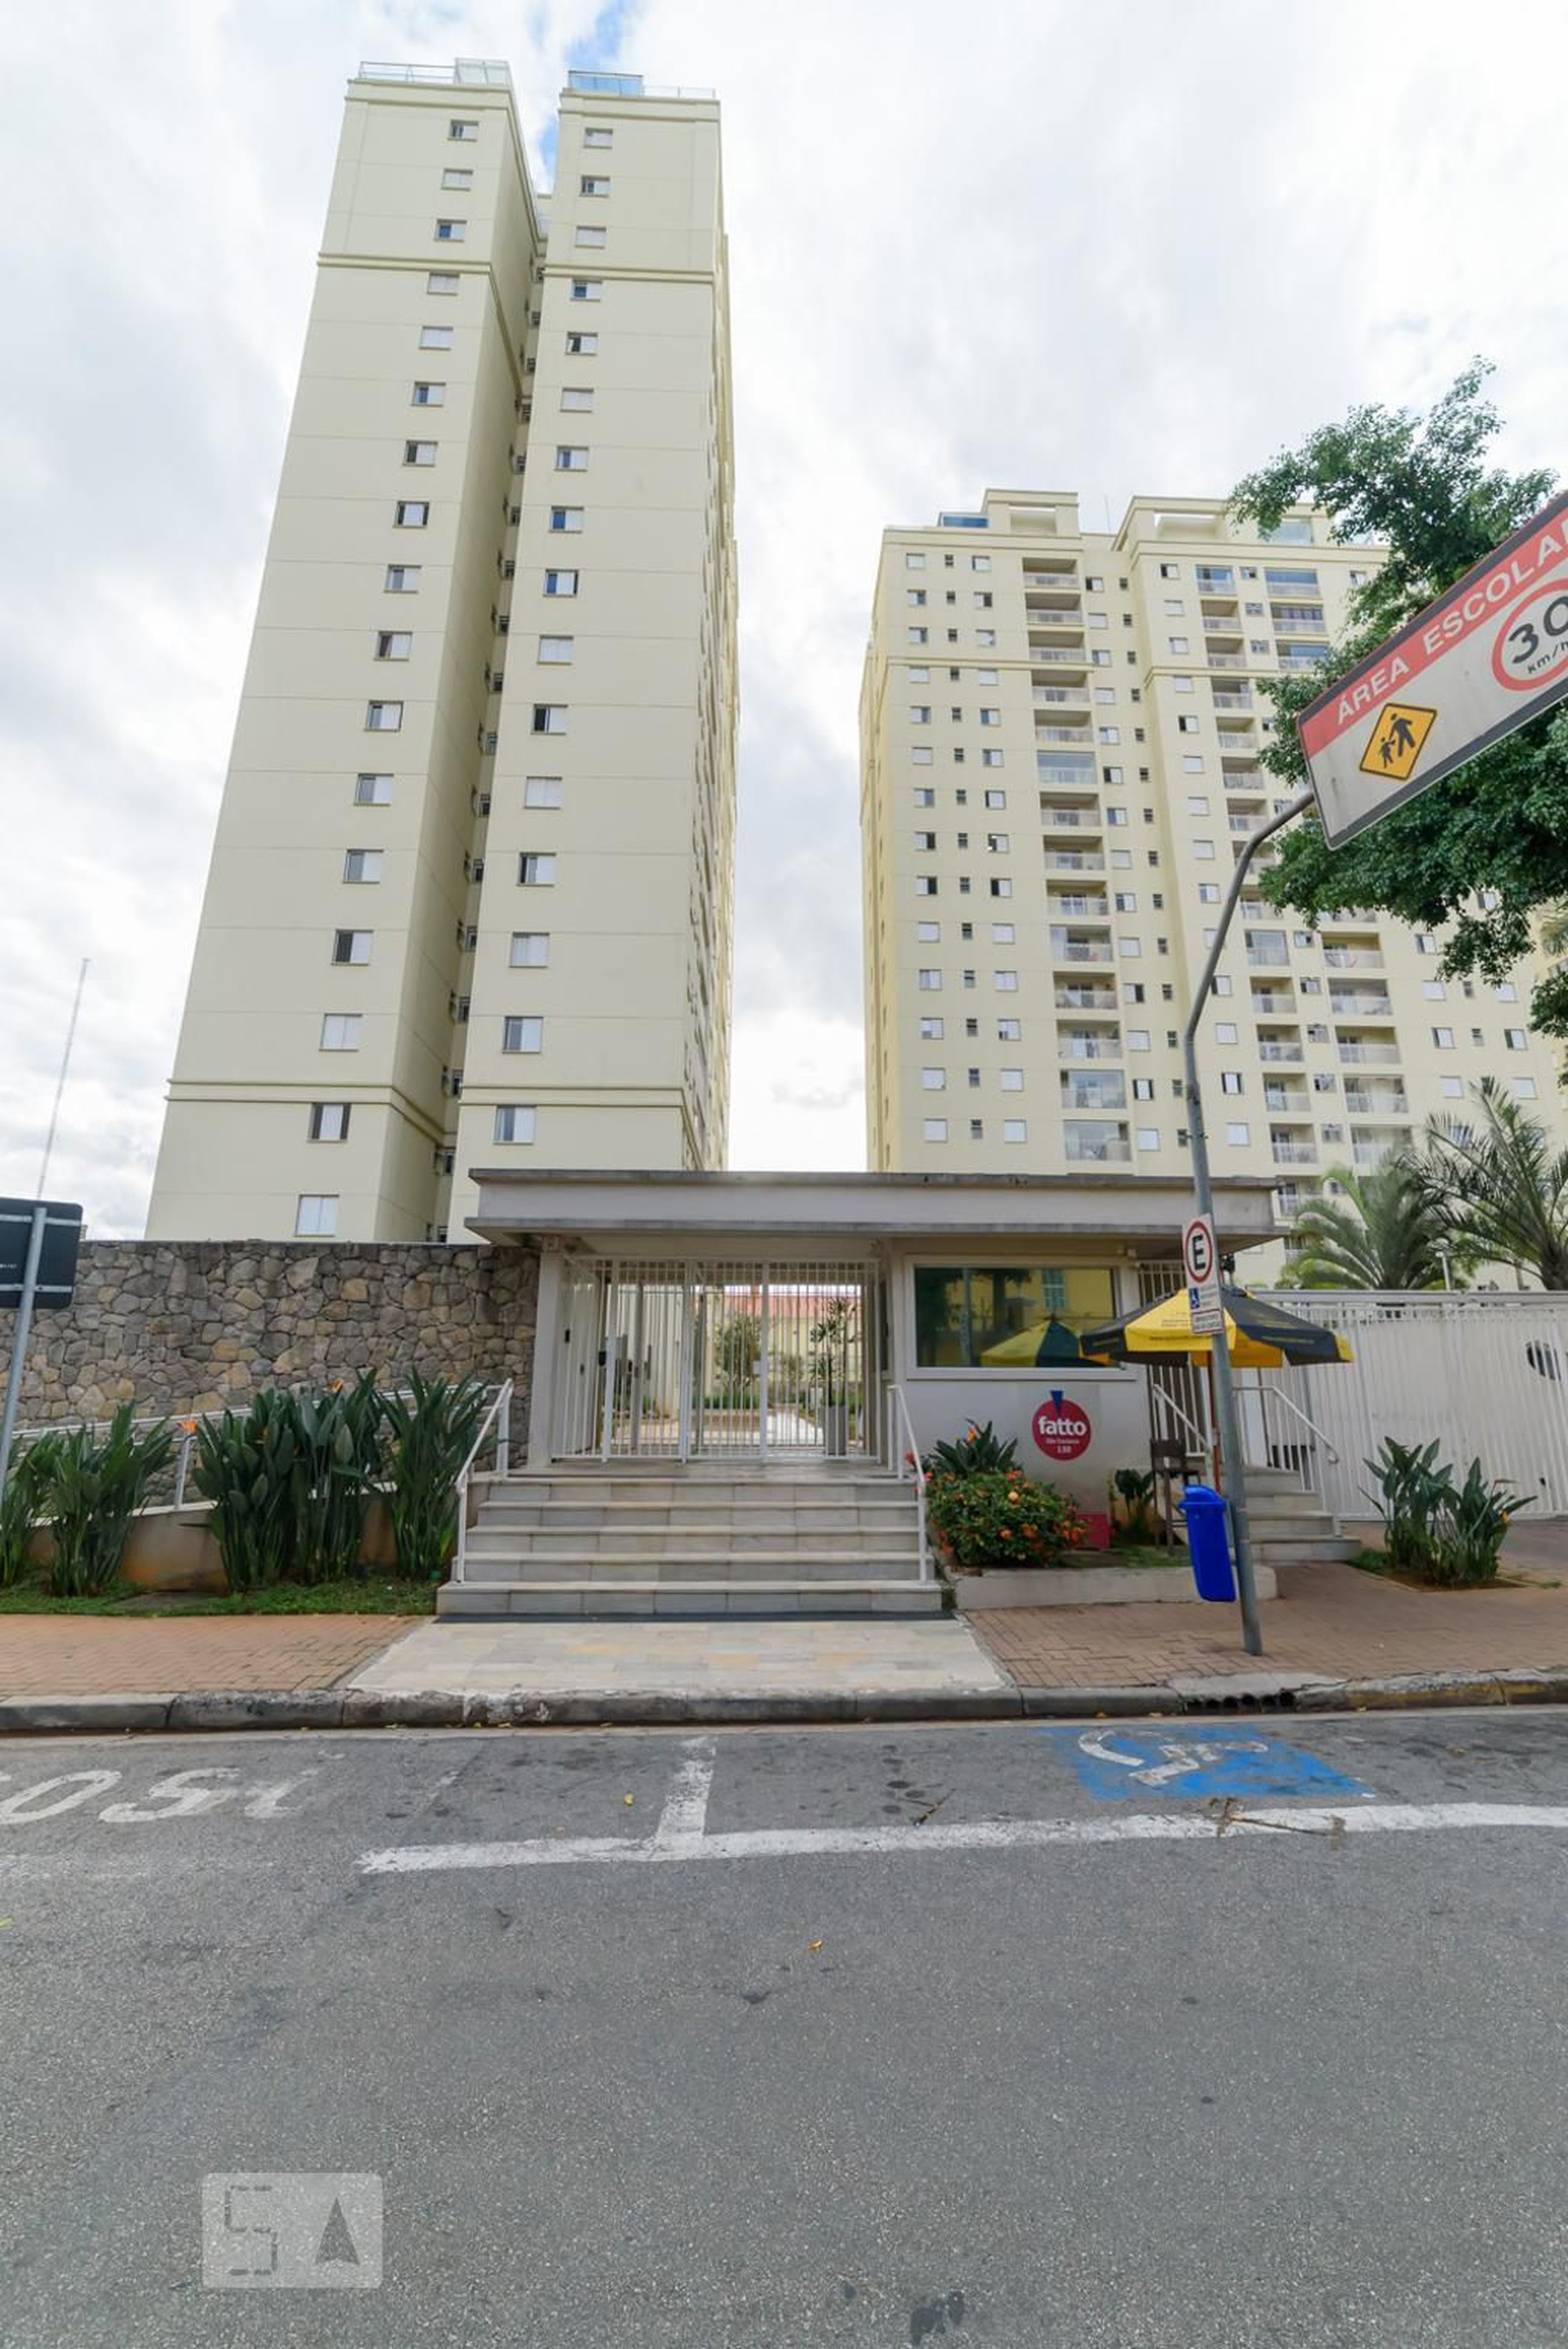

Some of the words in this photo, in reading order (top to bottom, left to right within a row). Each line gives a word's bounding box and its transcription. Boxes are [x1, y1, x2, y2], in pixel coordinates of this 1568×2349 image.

[1509, 596, 1568, 664] 30
[1337, 656, 1409, 725] ÁREA
[1192, 1234, 1206, 1271] E
[1038, 1416, 1087, 1436] fatto
